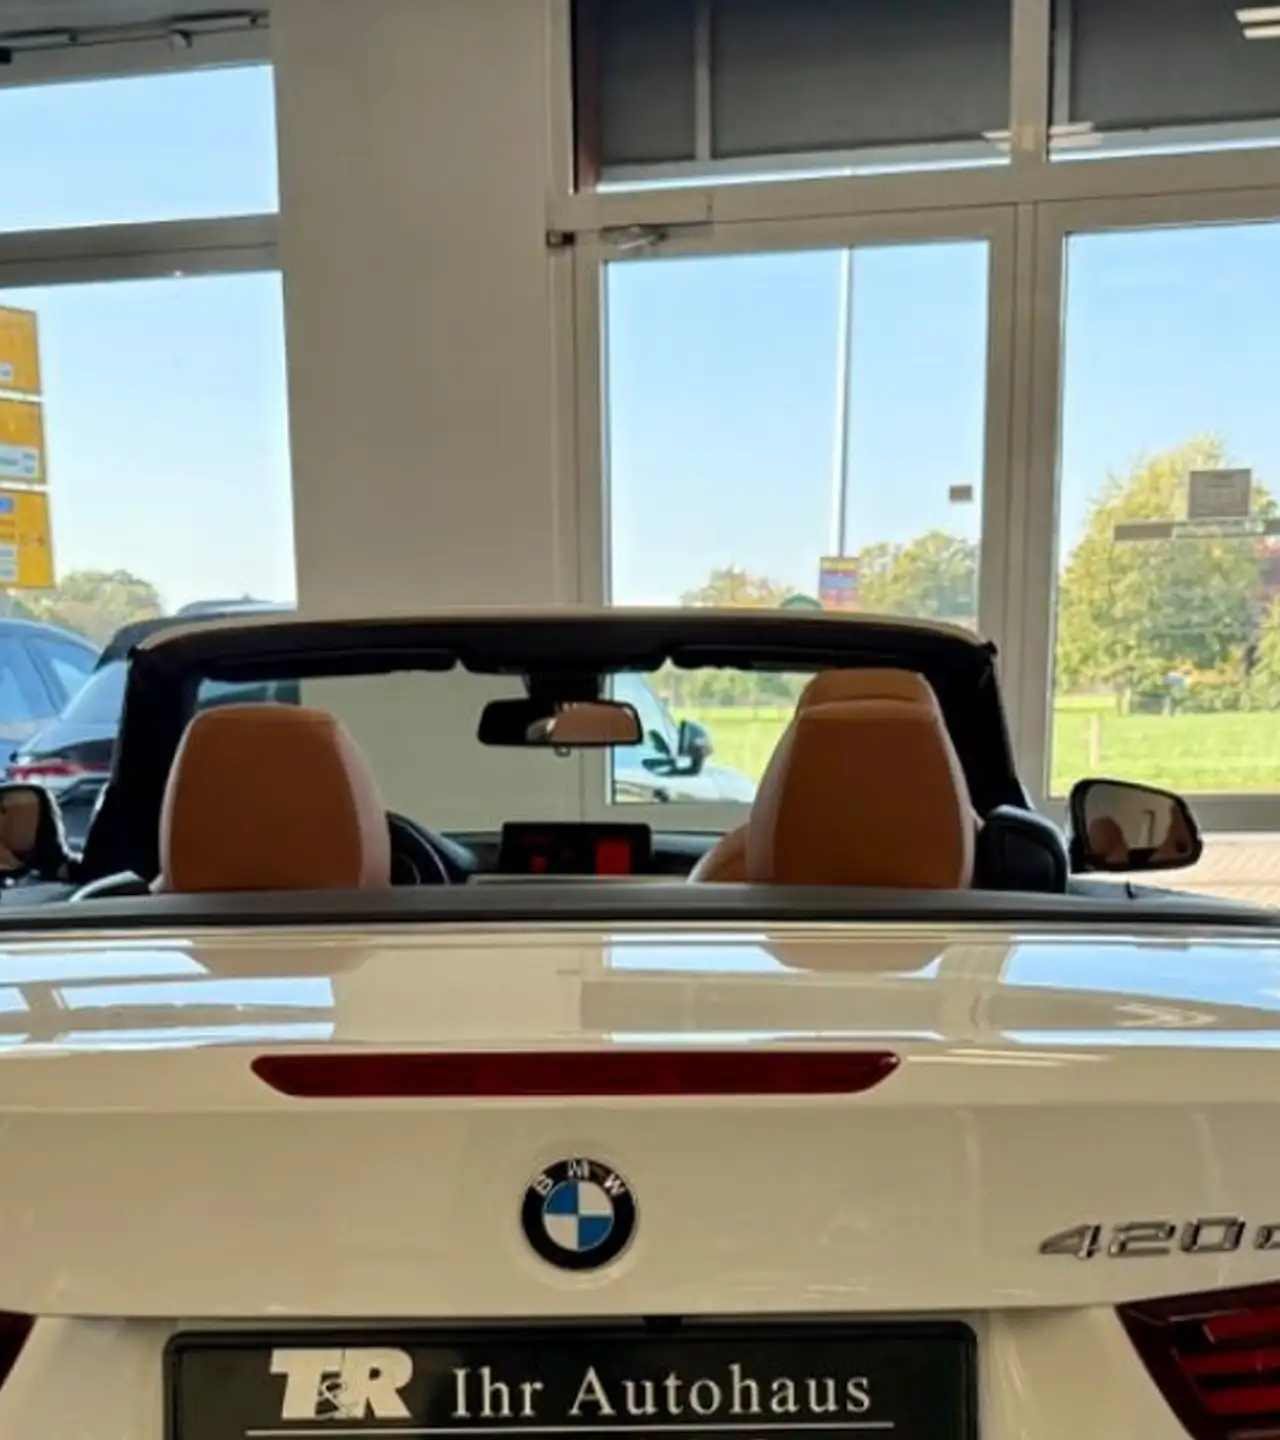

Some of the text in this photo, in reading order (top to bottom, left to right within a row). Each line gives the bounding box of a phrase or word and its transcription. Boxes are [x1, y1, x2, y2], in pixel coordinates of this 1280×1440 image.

[532, 1158, 627, 1197] BMW
[451, 1366, 544, 1417] Ihr
[569, 1362, 871, 1416] Autohaus
